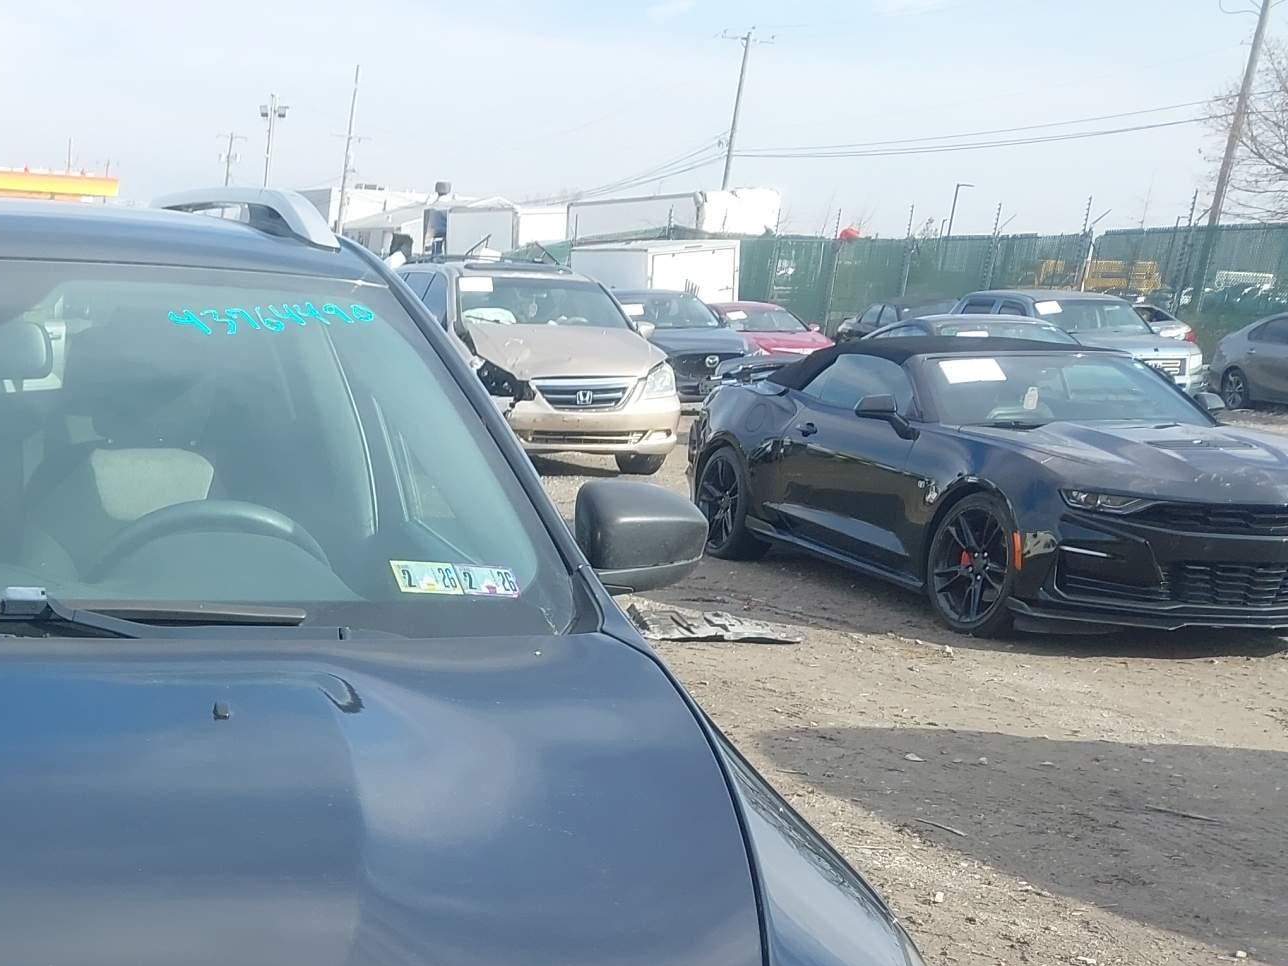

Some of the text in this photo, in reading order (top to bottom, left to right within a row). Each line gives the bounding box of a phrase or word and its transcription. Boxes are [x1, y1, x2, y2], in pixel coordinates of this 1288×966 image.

[168, 302, 374, 335] 43764490
[401, 567, 457, 588] 2 26
[463, 571, 517, 591] 2 26
